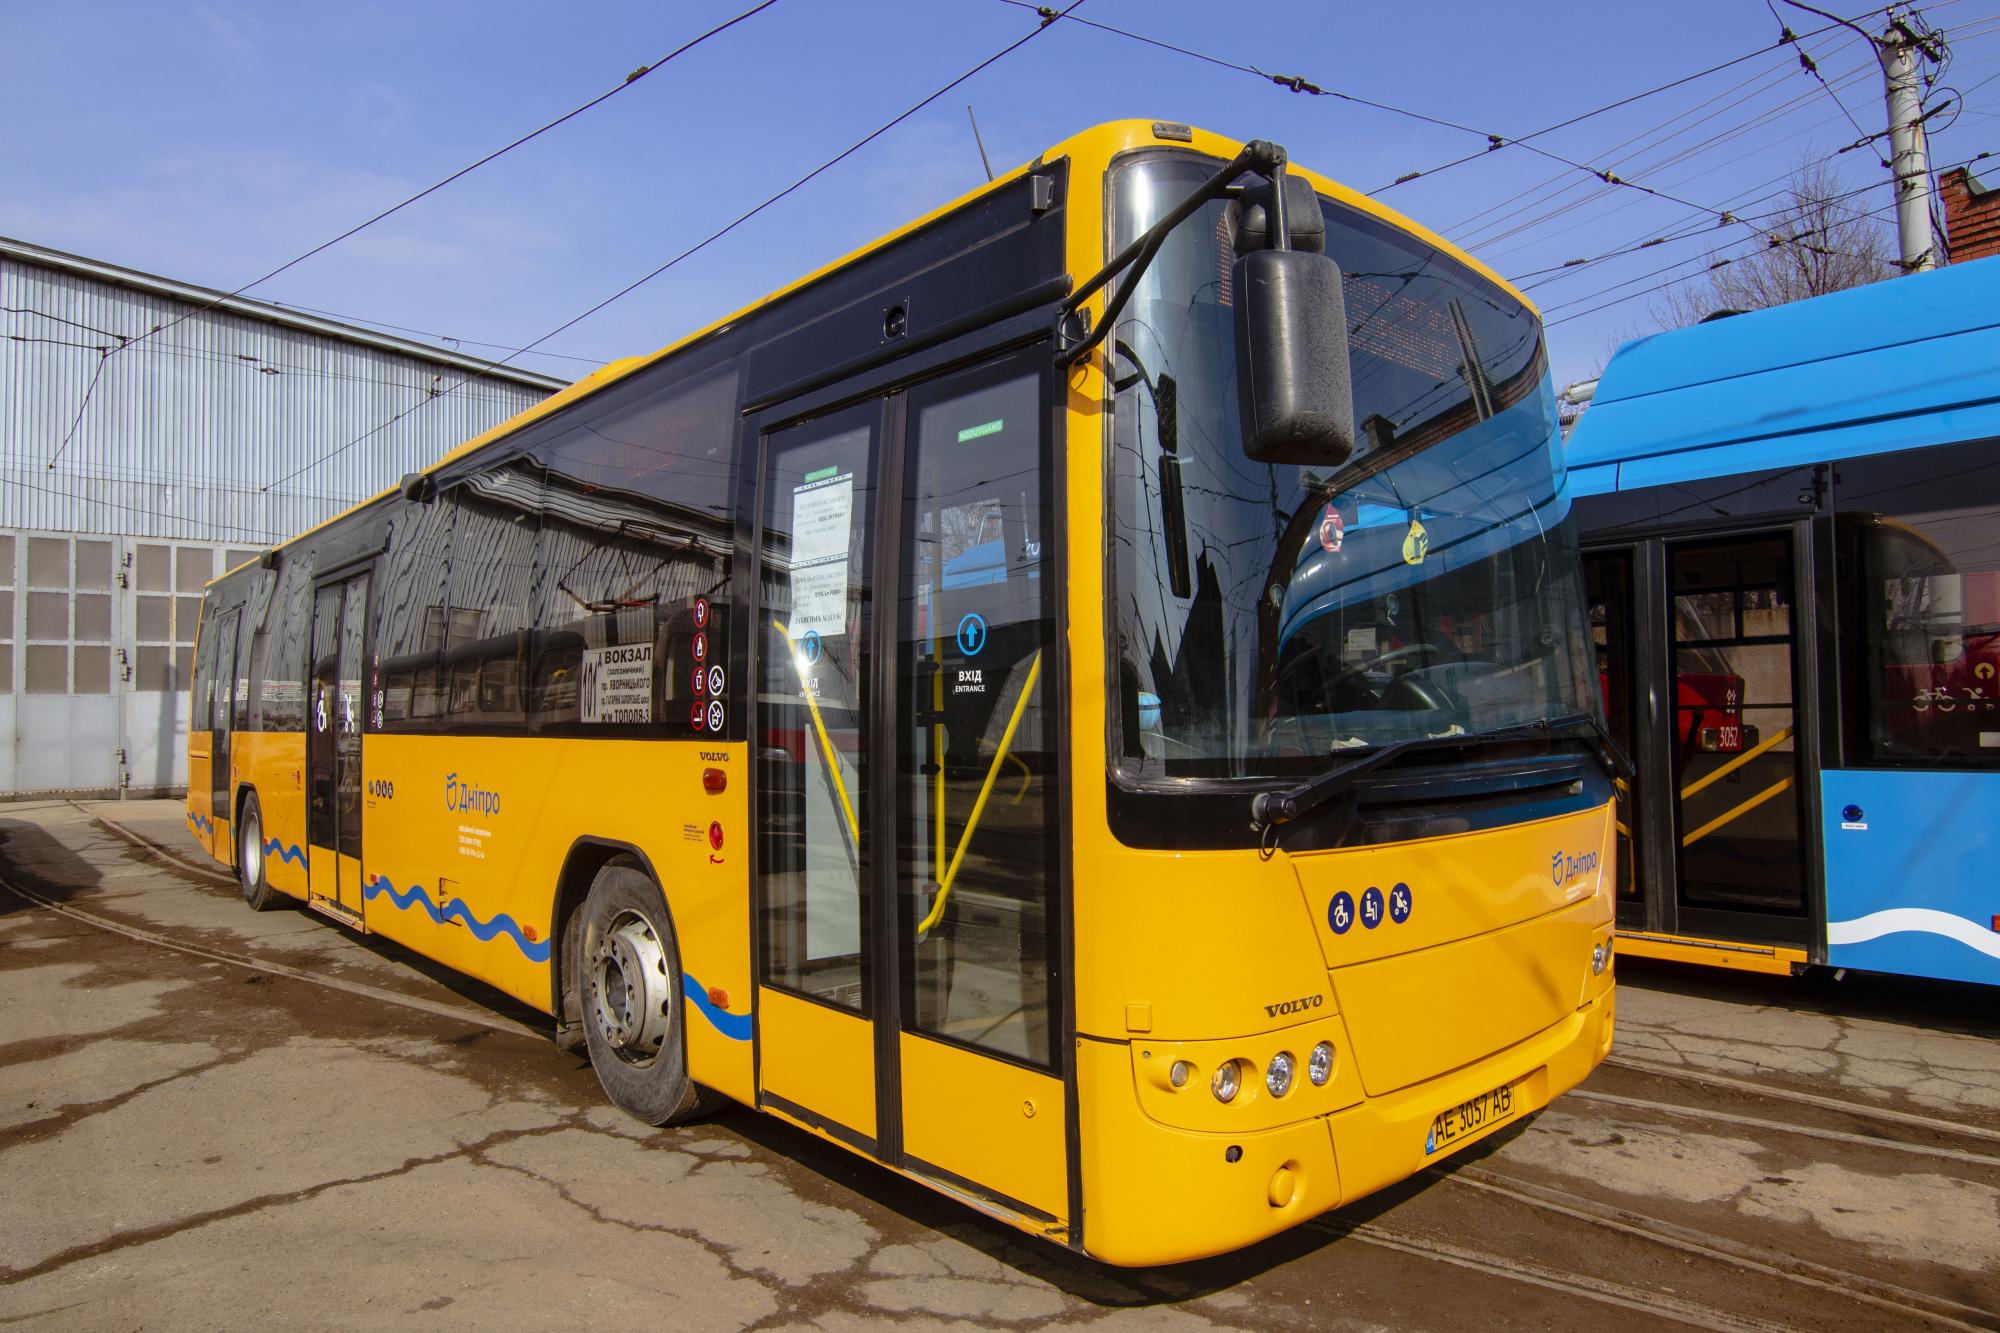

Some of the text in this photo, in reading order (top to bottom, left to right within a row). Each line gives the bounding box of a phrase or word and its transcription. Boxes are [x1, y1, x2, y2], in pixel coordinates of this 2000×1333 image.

[604, 647, 651, 664] ВОКЗАЛ
[958, 670, 982, 683] ВХІД
[699, 752, 729, 762] VOLVO
[459, 783, 501, 818] Дніпро
[1565, 851, 1597, 884] Дніпро
[1263, 994, 1323, 1018] VOLVO
[1435, 1085, 1512, 1145] AE 3057 AB
